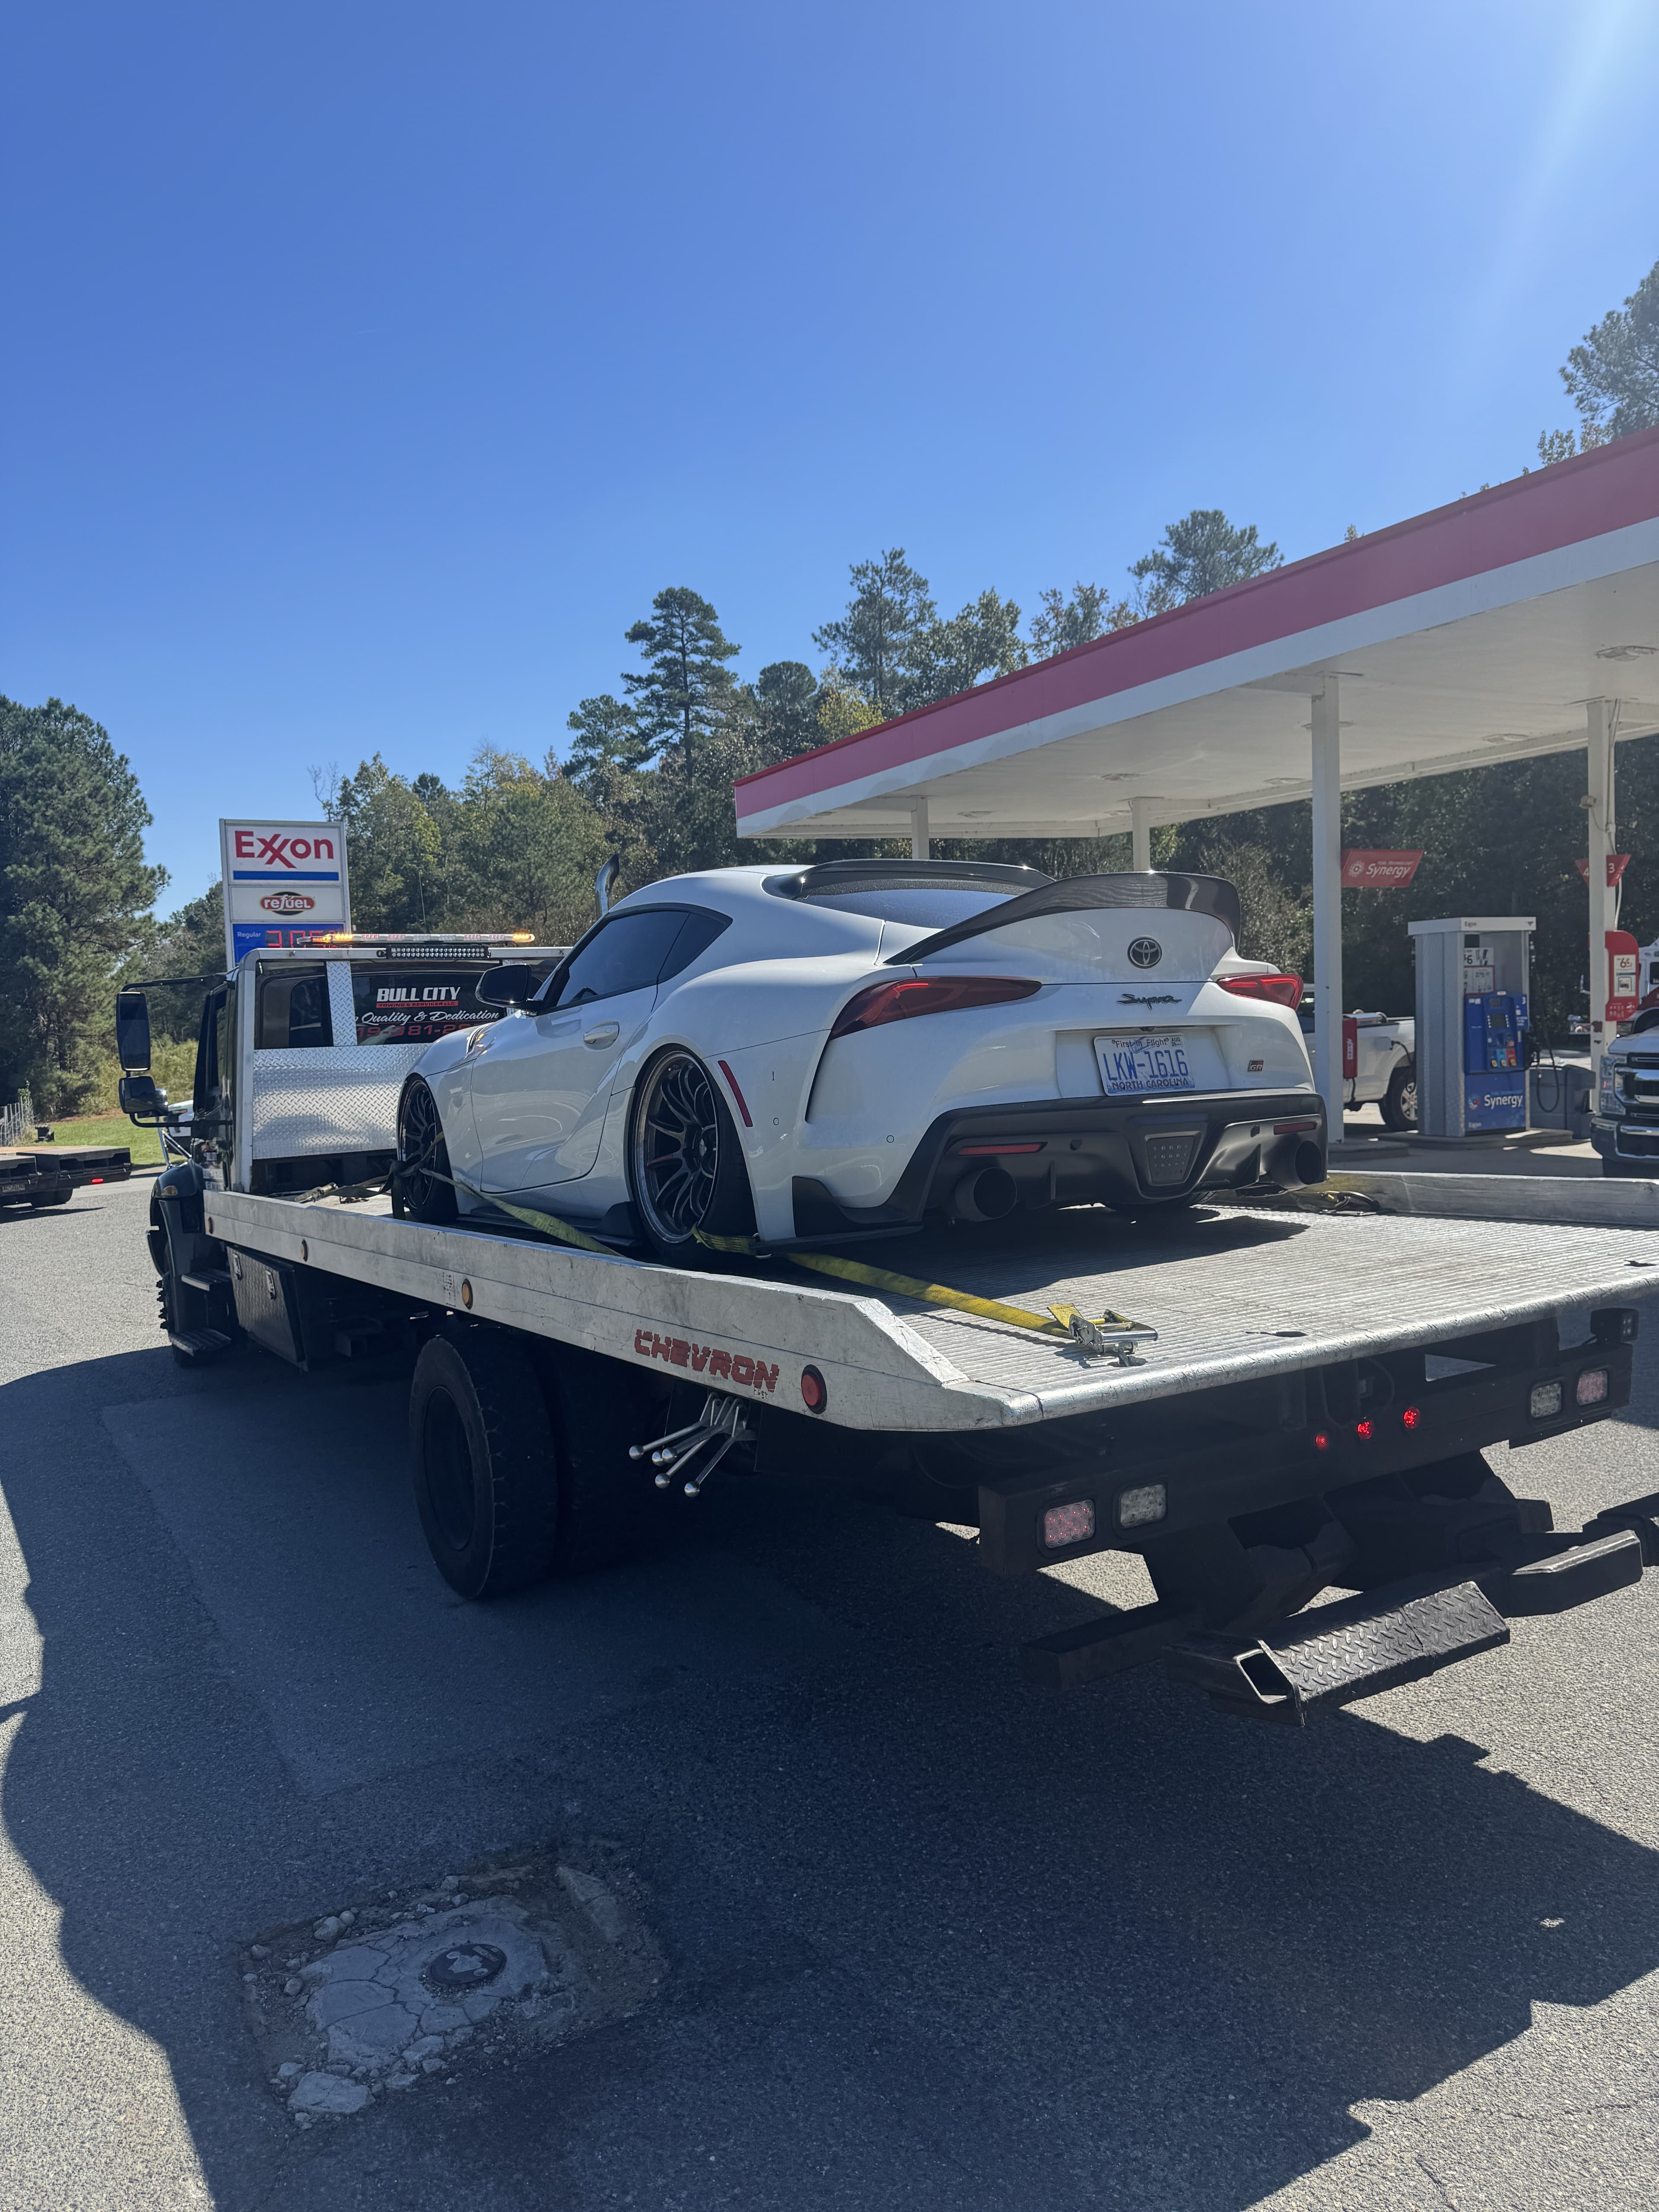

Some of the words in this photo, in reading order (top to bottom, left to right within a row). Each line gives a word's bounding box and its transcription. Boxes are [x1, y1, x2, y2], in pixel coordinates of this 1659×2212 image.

[235, 830, 334, 869] Exxon
[1366, 864, 1411, 878] Synergy
[1583, 868, 1589, 877] 4
[1608, 863, 1615, 873] 3
[376, 988, 420, 1002] BULL
[423, 987, 461, 1001] CITY
[1116, 994, 1182, 1011] Supra
[361, 1012, 410, 1026] Quality
[413, 1011, 428, 1022] &
[429, 1010, 500, 1021] Dedication
[1147, 1038, 1167, 1047] Flight
[1103, 1049, 1189, 1081] LKW-1616
[1112, 1081, 1143, 1090] NORTH
[1146, 1078, 1189, 1088] CAROLINA
[1484, 1094, 1523, 1109] Synergy
[634, 1329, 779, 1392] CHEVRON
